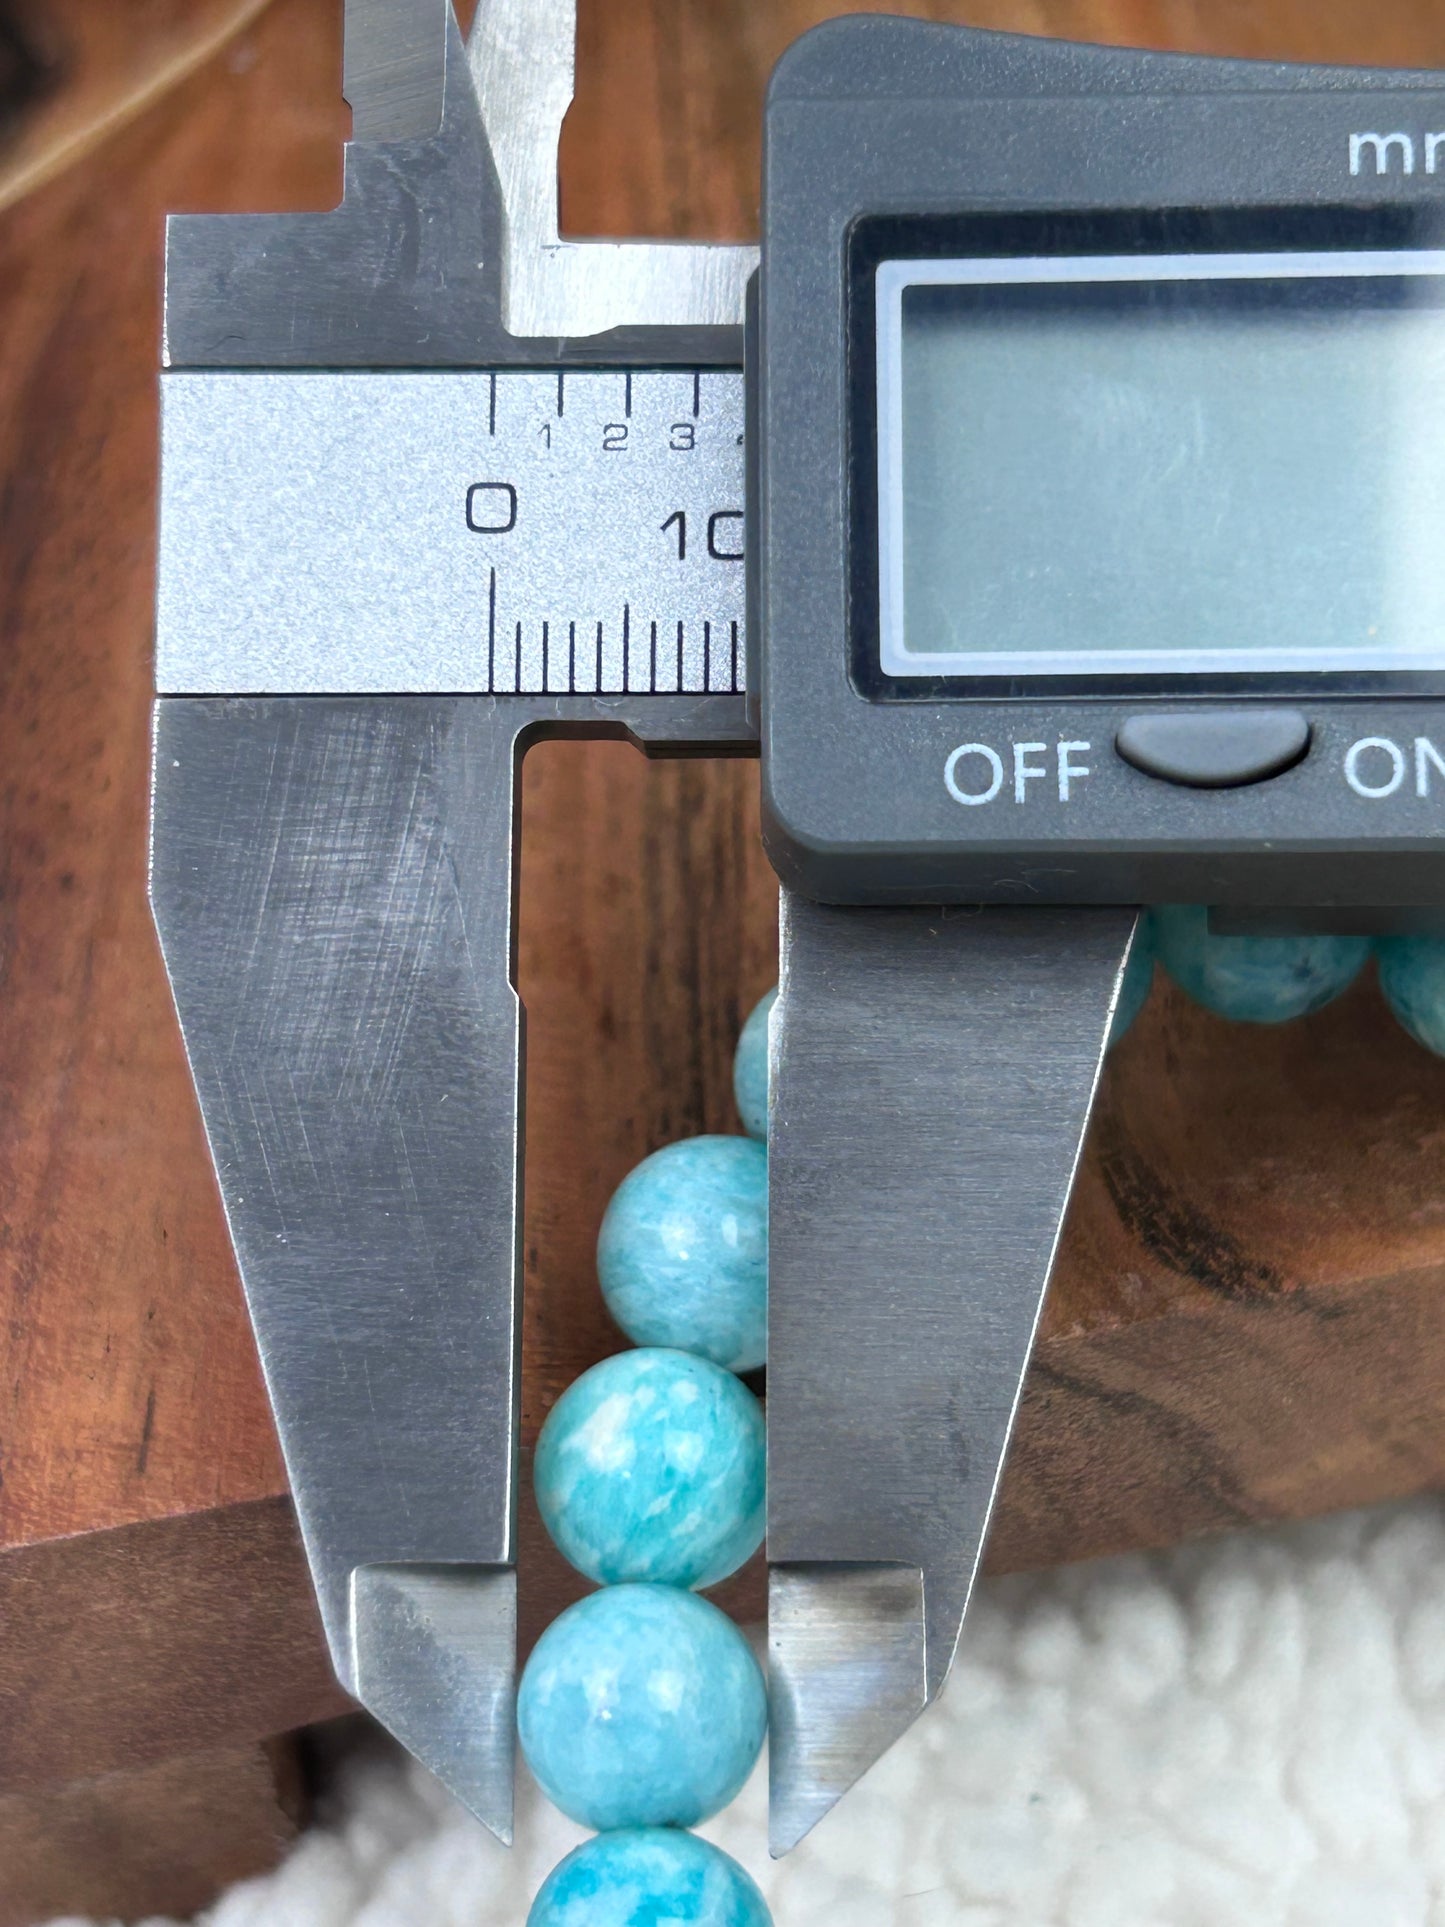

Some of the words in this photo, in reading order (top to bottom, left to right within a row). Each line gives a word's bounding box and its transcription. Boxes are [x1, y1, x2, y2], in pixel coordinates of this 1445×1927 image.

[537, 423, 550, 449] 1
[602, 423, 629, 451] 2
[669, 423, 695, 451] 3
[465, 482, 517, 534] 0
[660, 510, 744, 560] 10
[943, 741, 1091, 806] OFF
